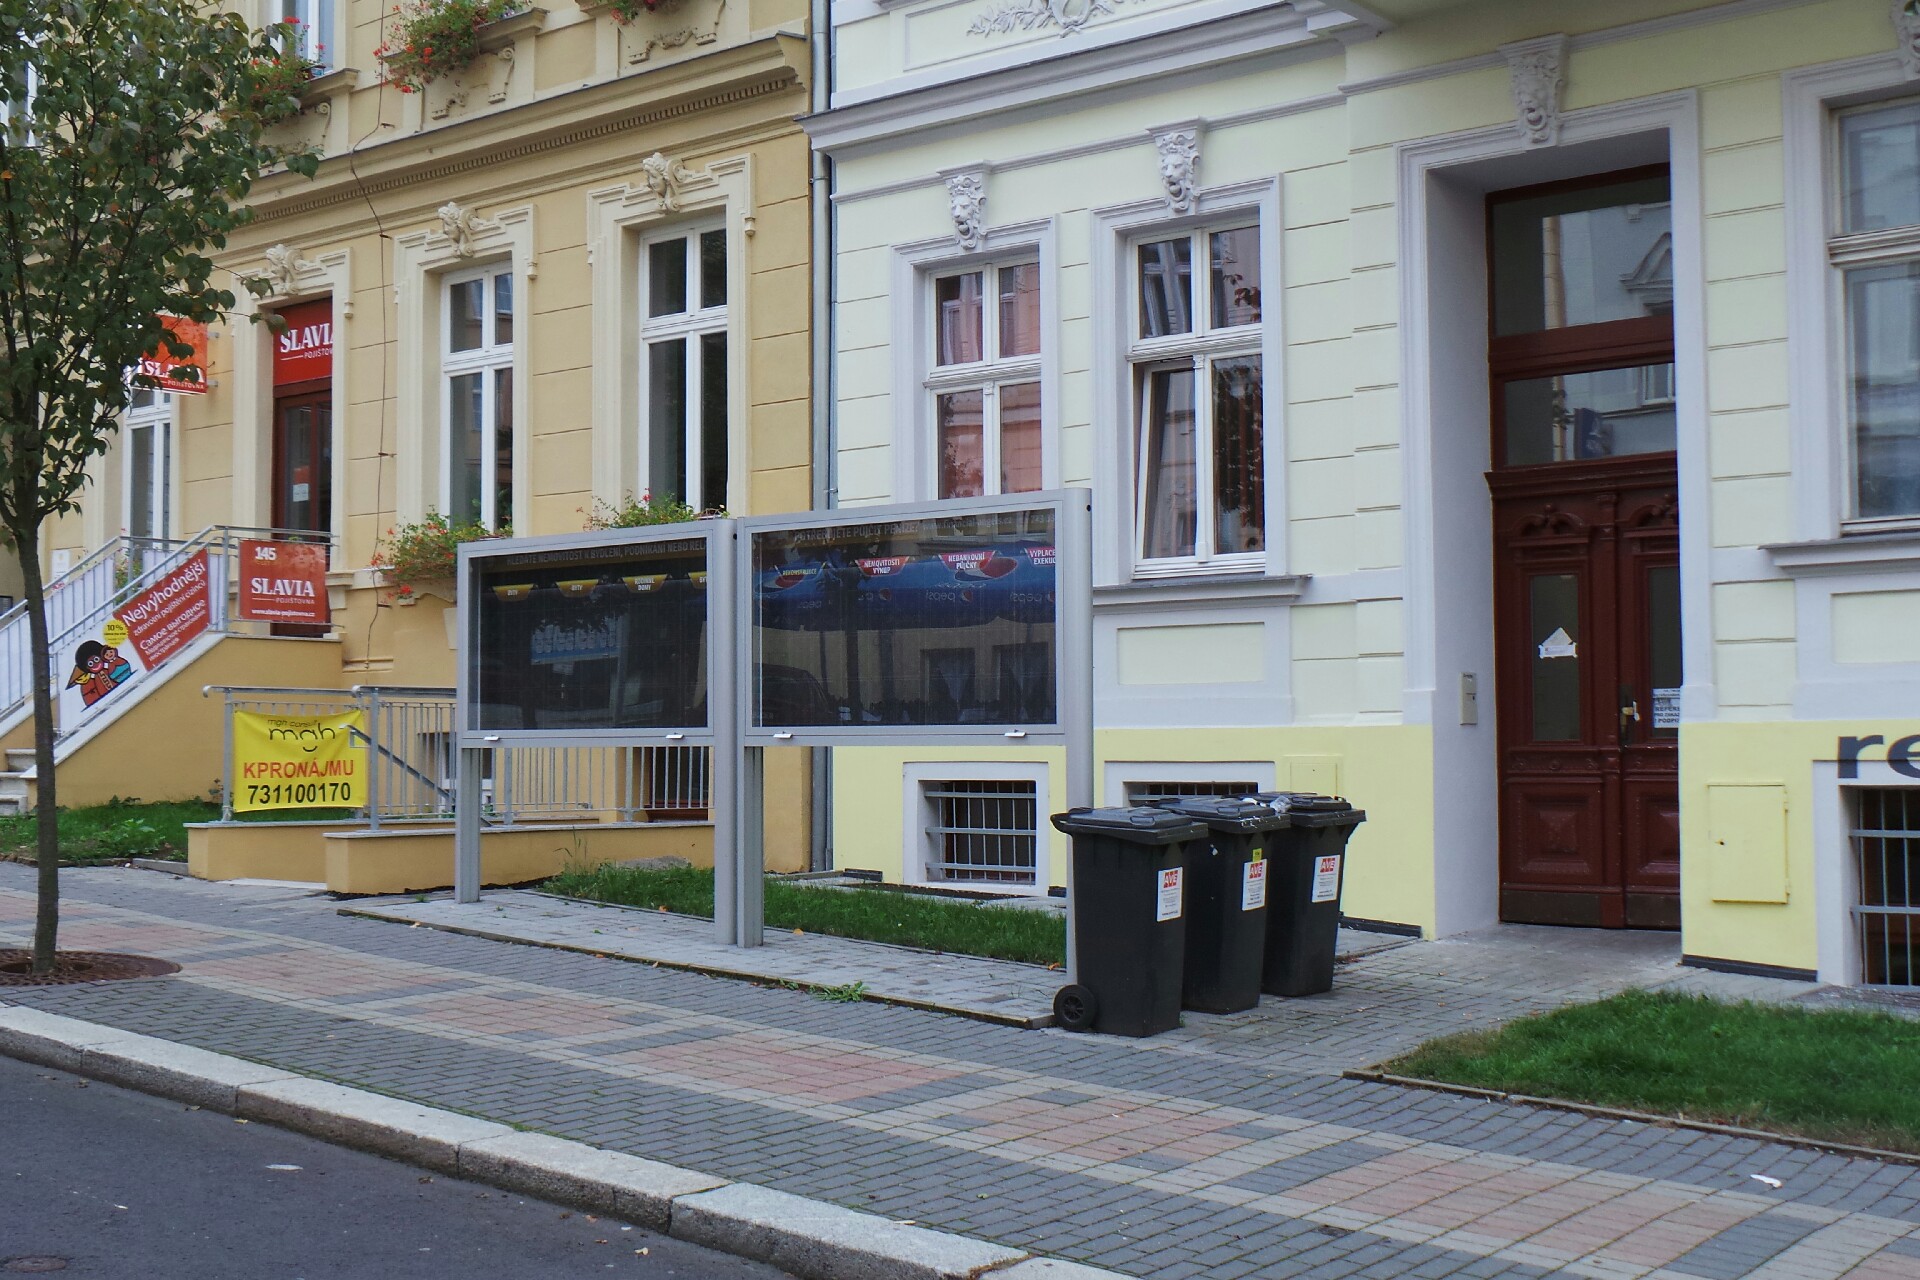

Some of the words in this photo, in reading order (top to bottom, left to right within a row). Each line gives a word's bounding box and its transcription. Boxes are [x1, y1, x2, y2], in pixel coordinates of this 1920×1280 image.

[255, 546, 277, 561] 145
[122, 559, 206, 627] Nejvýhodnější
[251, 577, 316, 597] SLAVIA
[140, 628, 168, 650] Самое
[247, 782, 351, 805] 731100170
[1249, 861, 1263, 879] AVE
[1320, 857, 1336, 873] AVE
[1163, 869, 1179, 889] AVE
